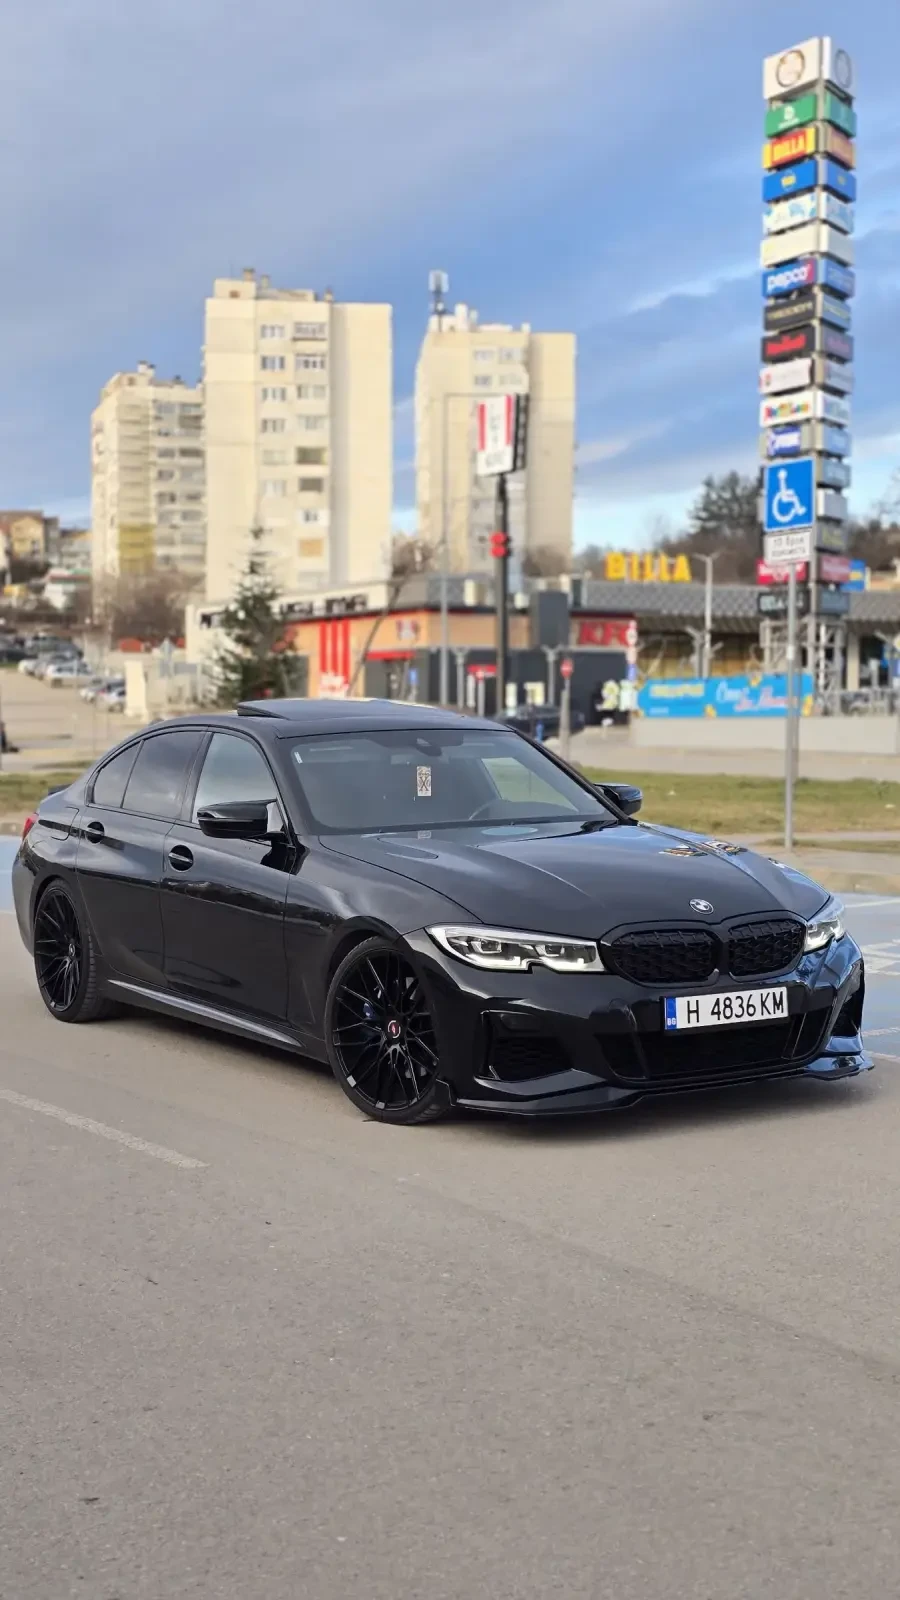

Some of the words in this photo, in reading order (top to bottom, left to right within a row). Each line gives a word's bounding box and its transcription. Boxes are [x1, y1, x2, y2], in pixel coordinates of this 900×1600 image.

[767, 264, 811, 293] pepco
[605, 552, 692, 582] BILLA
[687, 1000, 699, 1024] H
[710, 994, 757, 1020] 4836
[760, 991, 784, 1016] KM
